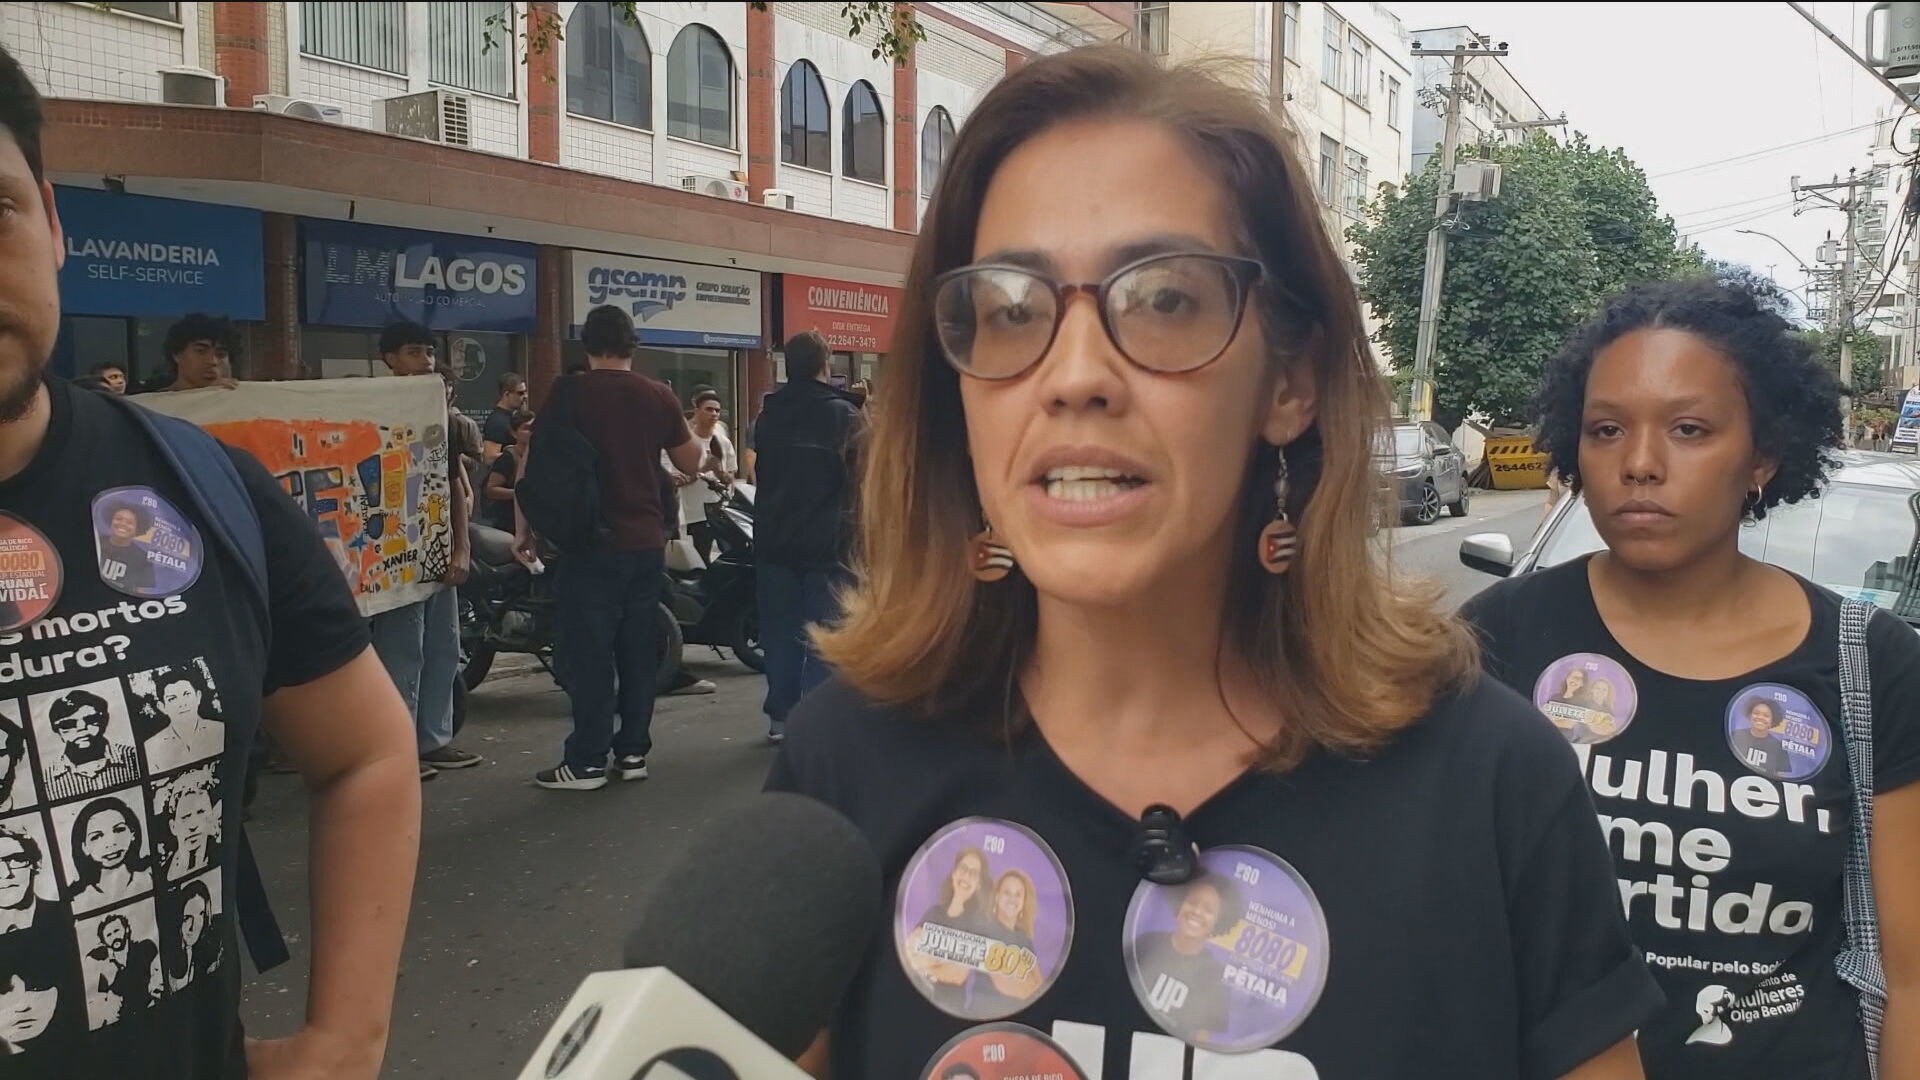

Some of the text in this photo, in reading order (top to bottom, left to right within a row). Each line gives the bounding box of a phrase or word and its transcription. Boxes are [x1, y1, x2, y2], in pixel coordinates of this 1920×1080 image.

[67, 237, 220, 266] LAVANDERIA
[87, 264, 205, 285] SELF-SERVICE
[808, 286, 888, 313] CONVENIÊNCIA
[102, 559, 127, 580] UP
[147, 550, 187, 570] PÉTALA
[383, 549, 418, 572] XAVIER
[31, 594, 187, 641] mortos
[0, 635, 131, 684] dura?
[1785, 720, 1814, 741] 8080
[1747, 747, 1768, 767] UP
[1781, 739, 1815, 757] PÉTALA
[1248, 900, 1288, 923] NENHUMA
[1235, 925, 1298, 971] 8080
[1645, 951, 1709, 972] Popular
[1712, 961, 1750, 975] pelo
[1223, 962, 1288, 1008] PÉTALA
[1781, 972, 1797, 983] de
[1151, 973, 1189, 1013] UP
[1730, 1008, 1760, 1023] Olga
